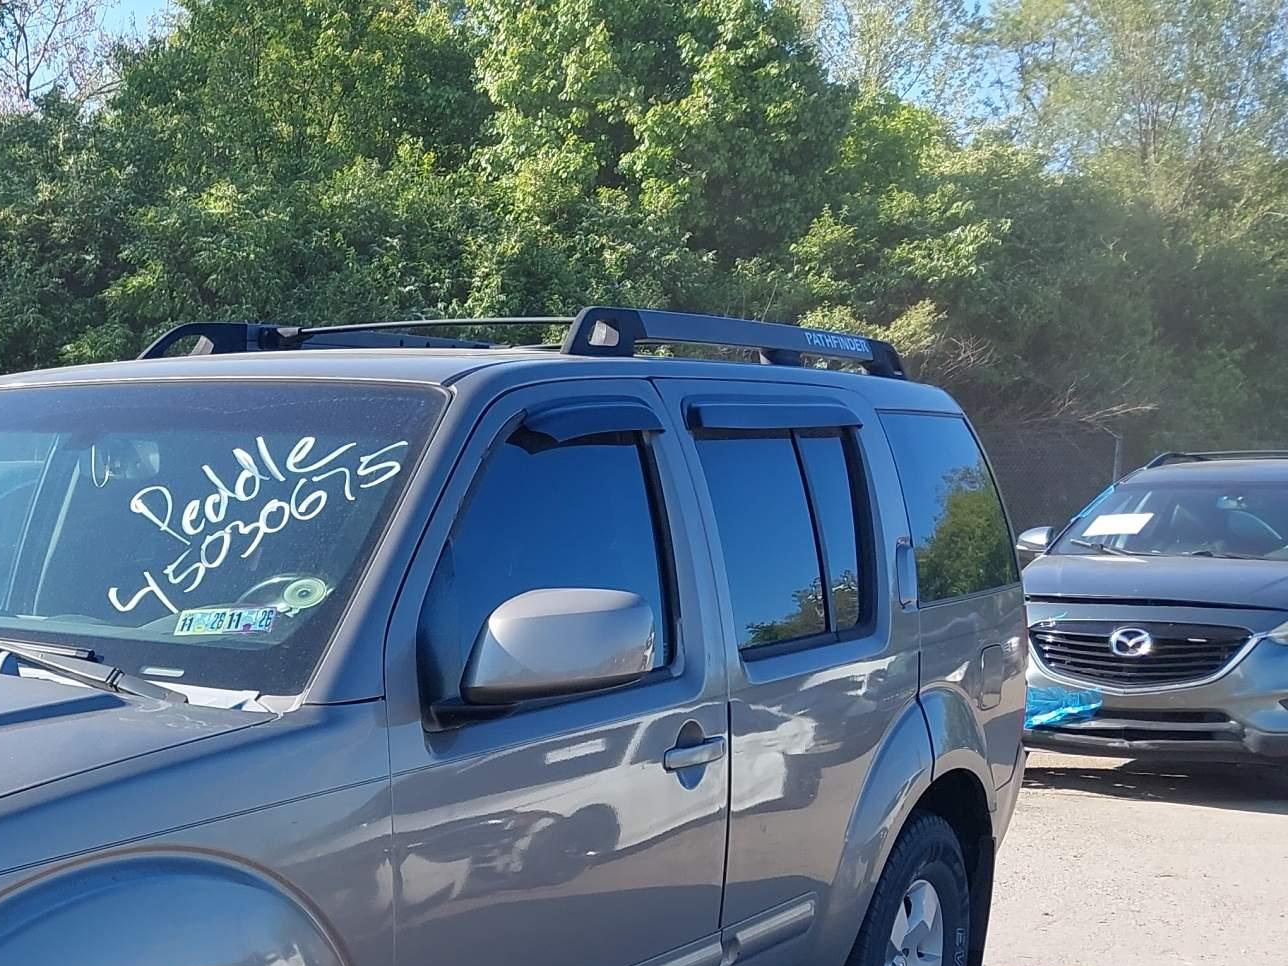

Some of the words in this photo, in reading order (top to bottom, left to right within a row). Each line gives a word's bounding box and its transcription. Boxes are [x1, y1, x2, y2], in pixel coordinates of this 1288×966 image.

[805, 332, 870, 353] PATHFINDER
[130, 437, 357, 545] Peddle
[108, 441, 409, 614] 45030675
[259, 609, 274, 628] 26
